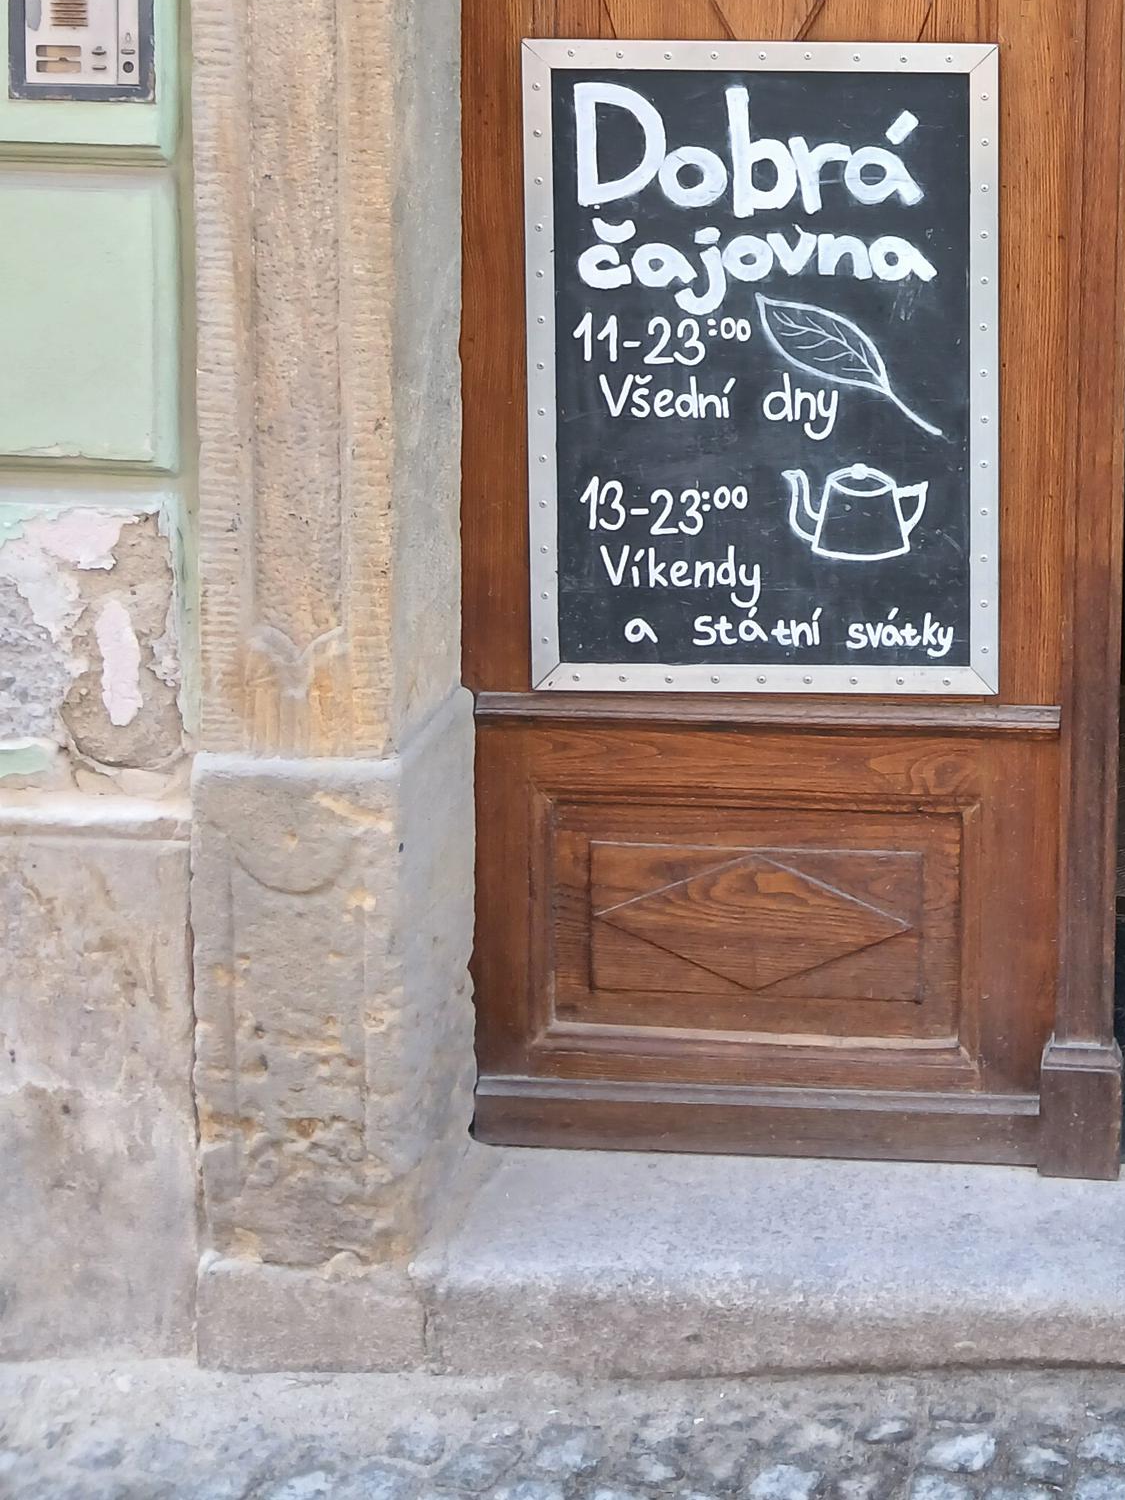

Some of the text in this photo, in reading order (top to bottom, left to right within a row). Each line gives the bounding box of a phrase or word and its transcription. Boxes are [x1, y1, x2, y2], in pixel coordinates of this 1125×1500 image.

[574, 82, 924, 217] Dobrá
[578, 218, 937, 315] čajovna
[599, 373, 839, 440] Všední dny
[600, 545, 760, 608] Víkendy
[625, 601, 953, 657] a státní svátky
